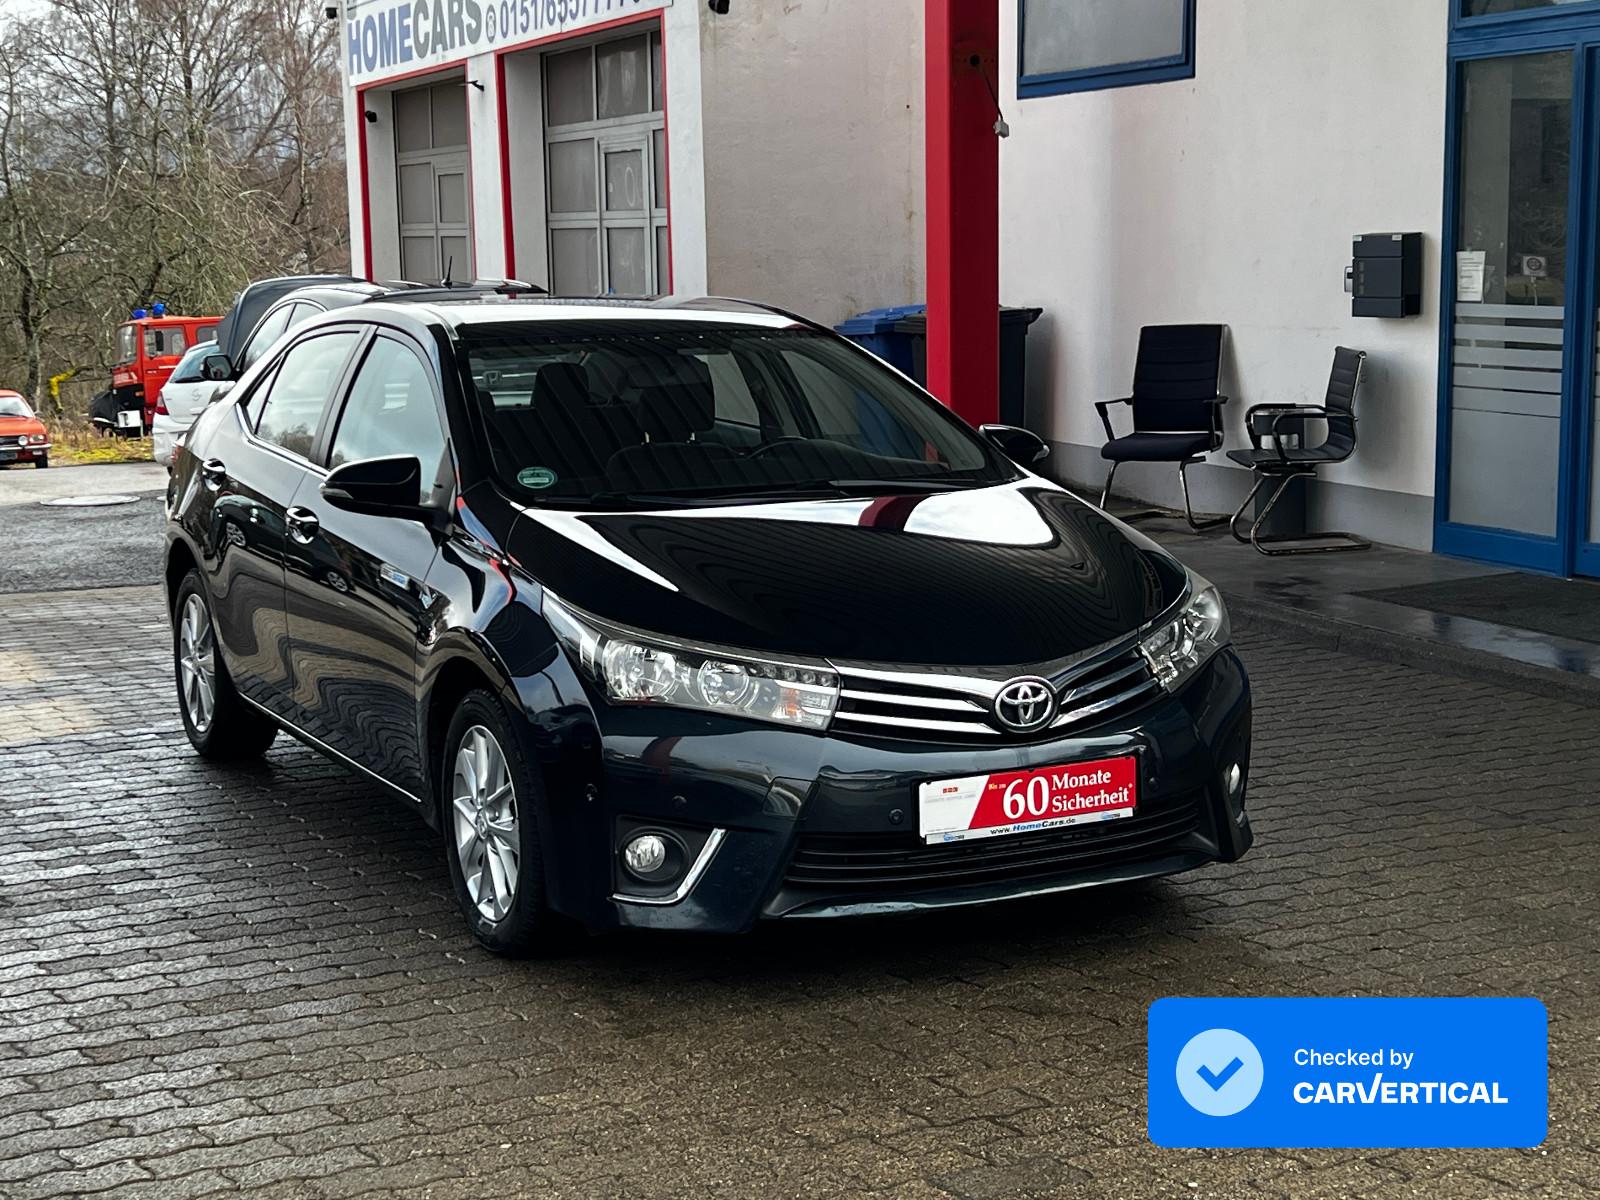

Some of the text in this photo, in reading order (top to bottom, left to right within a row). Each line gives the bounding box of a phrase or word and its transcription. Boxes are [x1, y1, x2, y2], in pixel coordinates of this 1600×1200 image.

[347, 0, 482, 75] HOMECARS
[1003, 770, 1111, 820] 60 Monate
[1052, 786, 1130, 812] Sicherheit
[990, 818, 1076, 835] www.HomeCars.de
